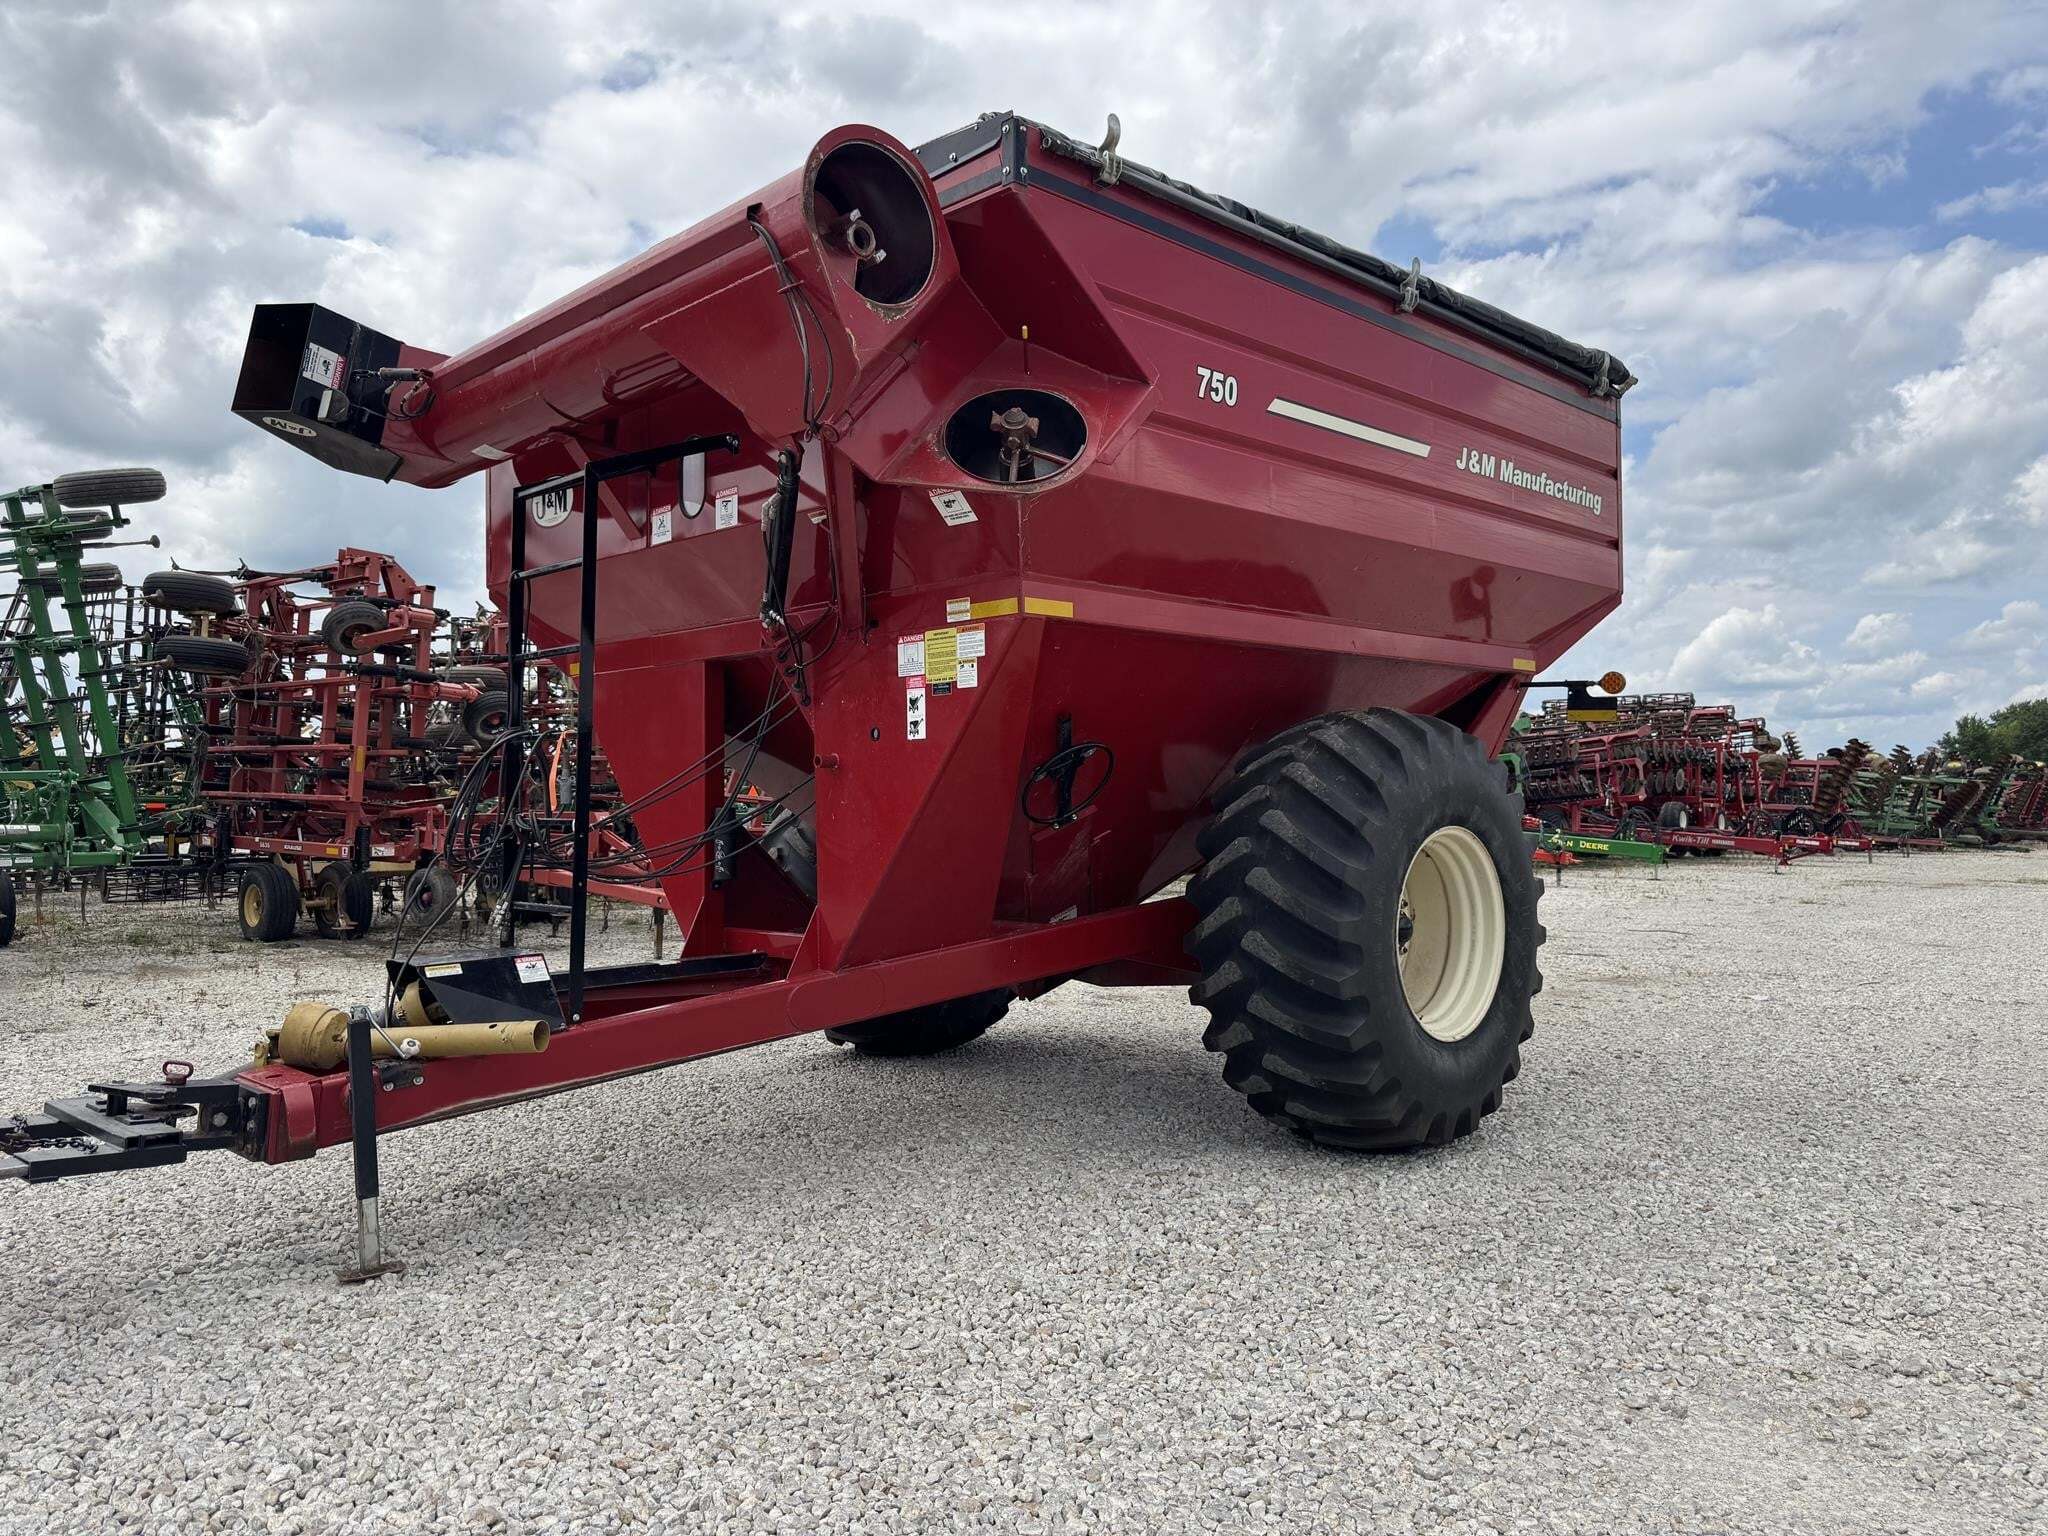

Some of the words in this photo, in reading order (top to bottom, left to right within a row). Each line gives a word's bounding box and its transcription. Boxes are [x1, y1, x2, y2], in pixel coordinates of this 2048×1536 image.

[1197, 365, 1238, 407] 750
[1456, 447, 1496, 478] J&M
[1499, 459, 1602, 516] Manufacturing
[719, 487, 738, 499] DANGER
[535, 489, 569, 520] J&M
[903, 634, 924, 642] DANGER
[1579, 840, 1609, 851] DEERE
[1671, 834, 1710, 846] Kwik-Till
